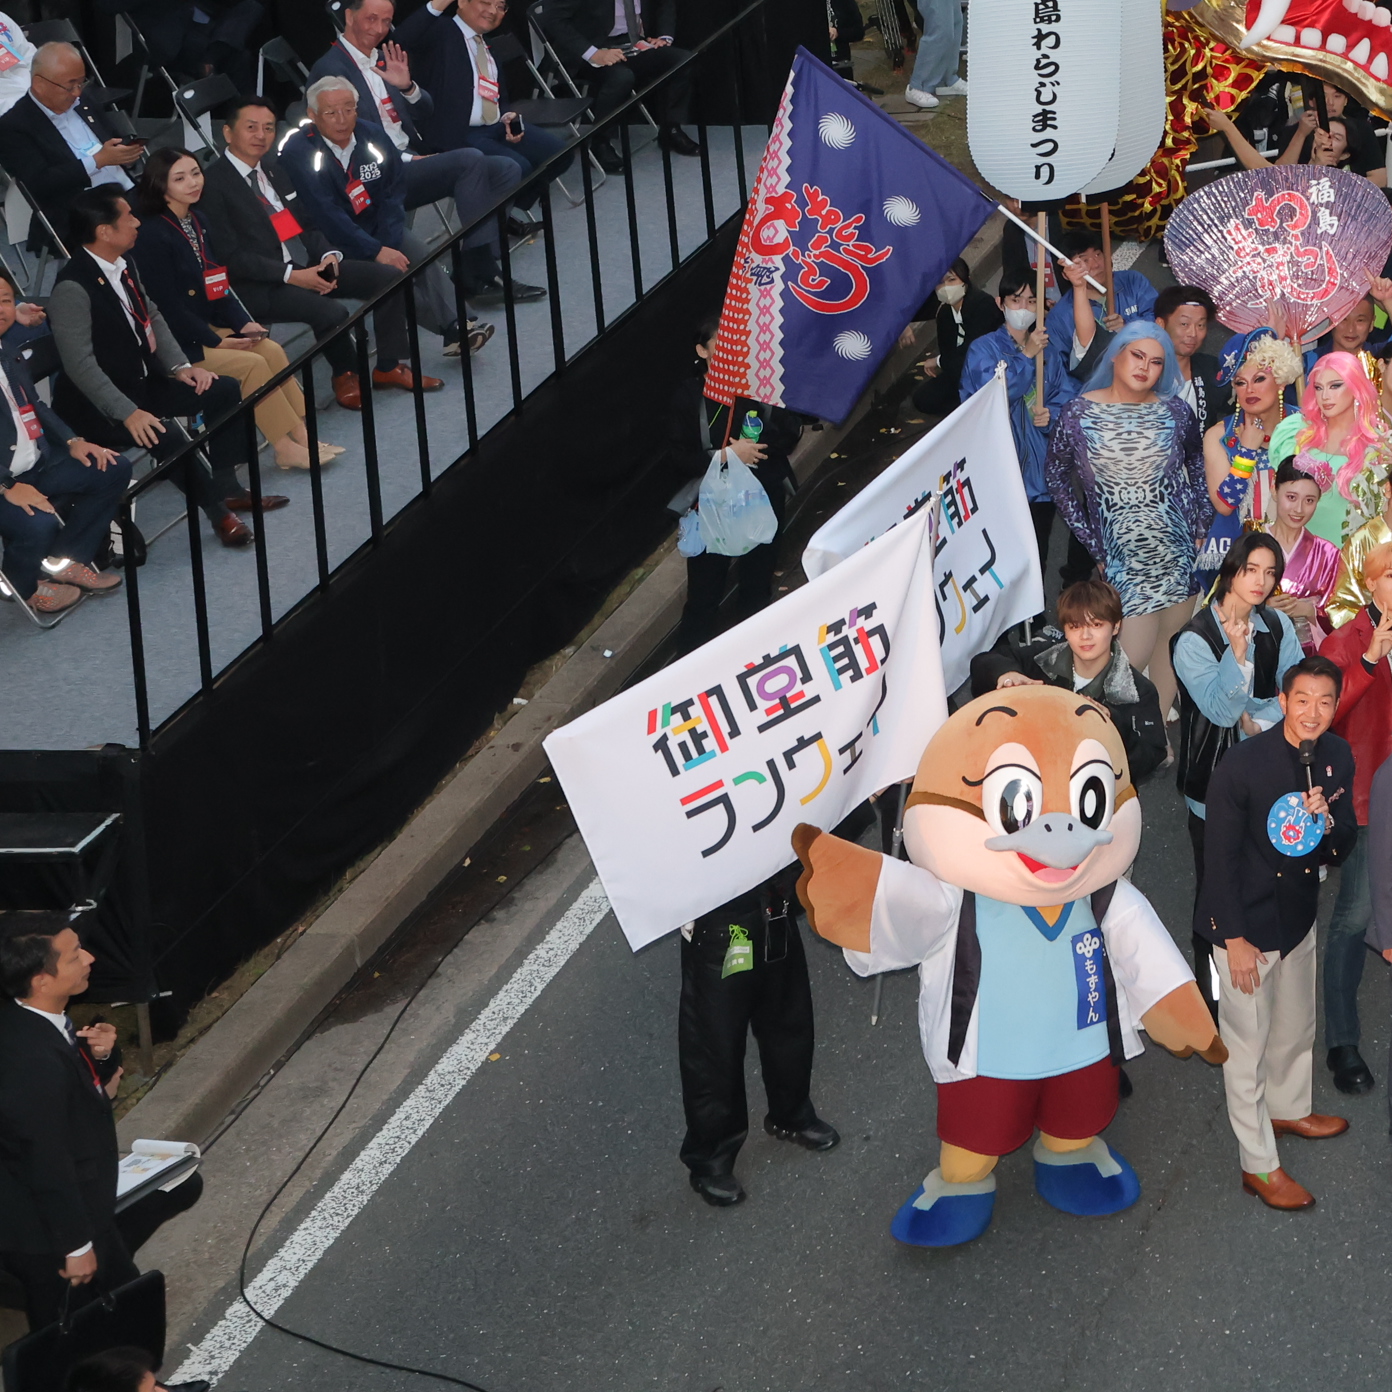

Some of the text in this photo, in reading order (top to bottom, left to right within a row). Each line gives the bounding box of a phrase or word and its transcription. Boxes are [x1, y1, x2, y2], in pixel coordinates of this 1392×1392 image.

[360, 169, 382, 181] 2025
[1308, 179, 1339, 235] 福島
[647, 602, 891, 778] 御堂筋
[680, 673, 888, 859] ランウェイ
[1085, 959, 1100, 1024] もずやん
